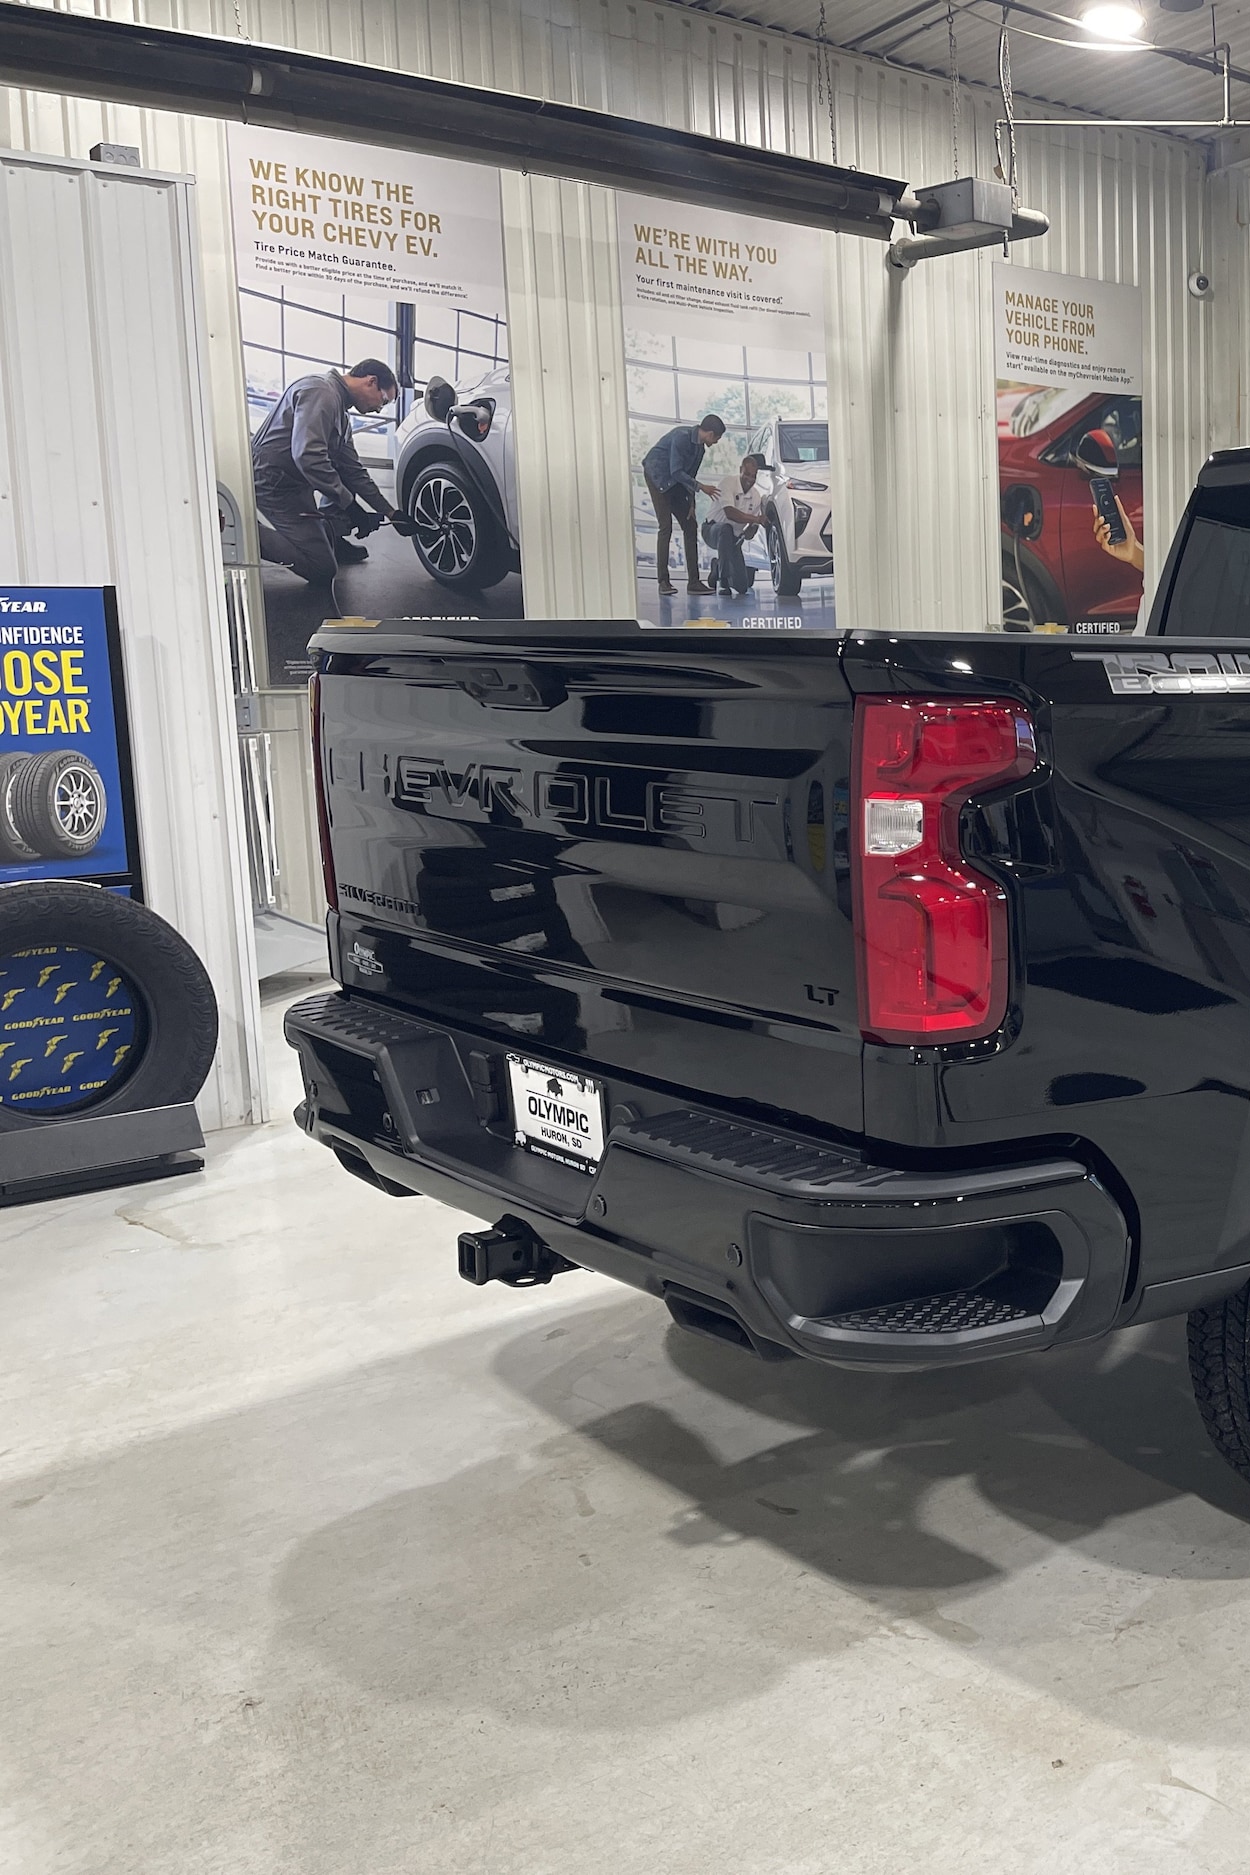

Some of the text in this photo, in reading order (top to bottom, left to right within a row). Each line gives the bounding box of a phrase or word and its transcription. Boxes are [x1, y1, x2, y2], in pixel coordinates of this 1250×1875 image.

[249, 158, 414, 205] WE KNOW THE
[252, 184, 442, 234] RIGHT TIRES FOR
[252, 210, 438, 258] YOUR CHEVY EV.
[634, 224, 777, 265] WE'RE WITH YOU
[254, 241, 396, 271] Tire Price Match Guarantee.
[255, 256, 276, 264] Provide
[635, 247, 753, 283] ALL THE WAY.
[636, 274, 654, 286] Your
[656, 278, 674, 290] first
[676, 283, 725, 298] maintenance
[727, 289, 742, 300] visit
[744, 292, 750, 301] is
[1005, 290, 1094, 320] MANAGE YOUR
[1005, 309, 1095, 338] VEHICLE FROM
[1006, 328, 1088, 355] YOUR PHONE.
[1006, 352, 1020, 360] View
[1021, 354, 1047, 365] real-time
[1049, 357, 1079, 370] diagnostics
[1081, 362, 1091, 370] and
[1092, 364, 1106, 374] enjoy
[1024, 364, 1048, 374] available
[1058, 369, 1066, 377] the
[1068, 370, 1101, 381] myChevrolet
[1102, 374, 1119, 382] Mobile
[0, 626, 84, 646] NFIDENCE
[742, 616, 802, 629] CERTIFIED
[1076, 622, 1120, 634] CERTIFIED
[0, 649, 88, 697] OSE
[803, 984, 840, 1006] LT
[4, 1008, 131, 1030] GOODYEAR GOODYEAR
[12, 1085, 72, 1100] GOODYEAR
[528, 1096, 589, 1134] OLYMPIC
[541, 1126, 582, 1149] HURON, SD
